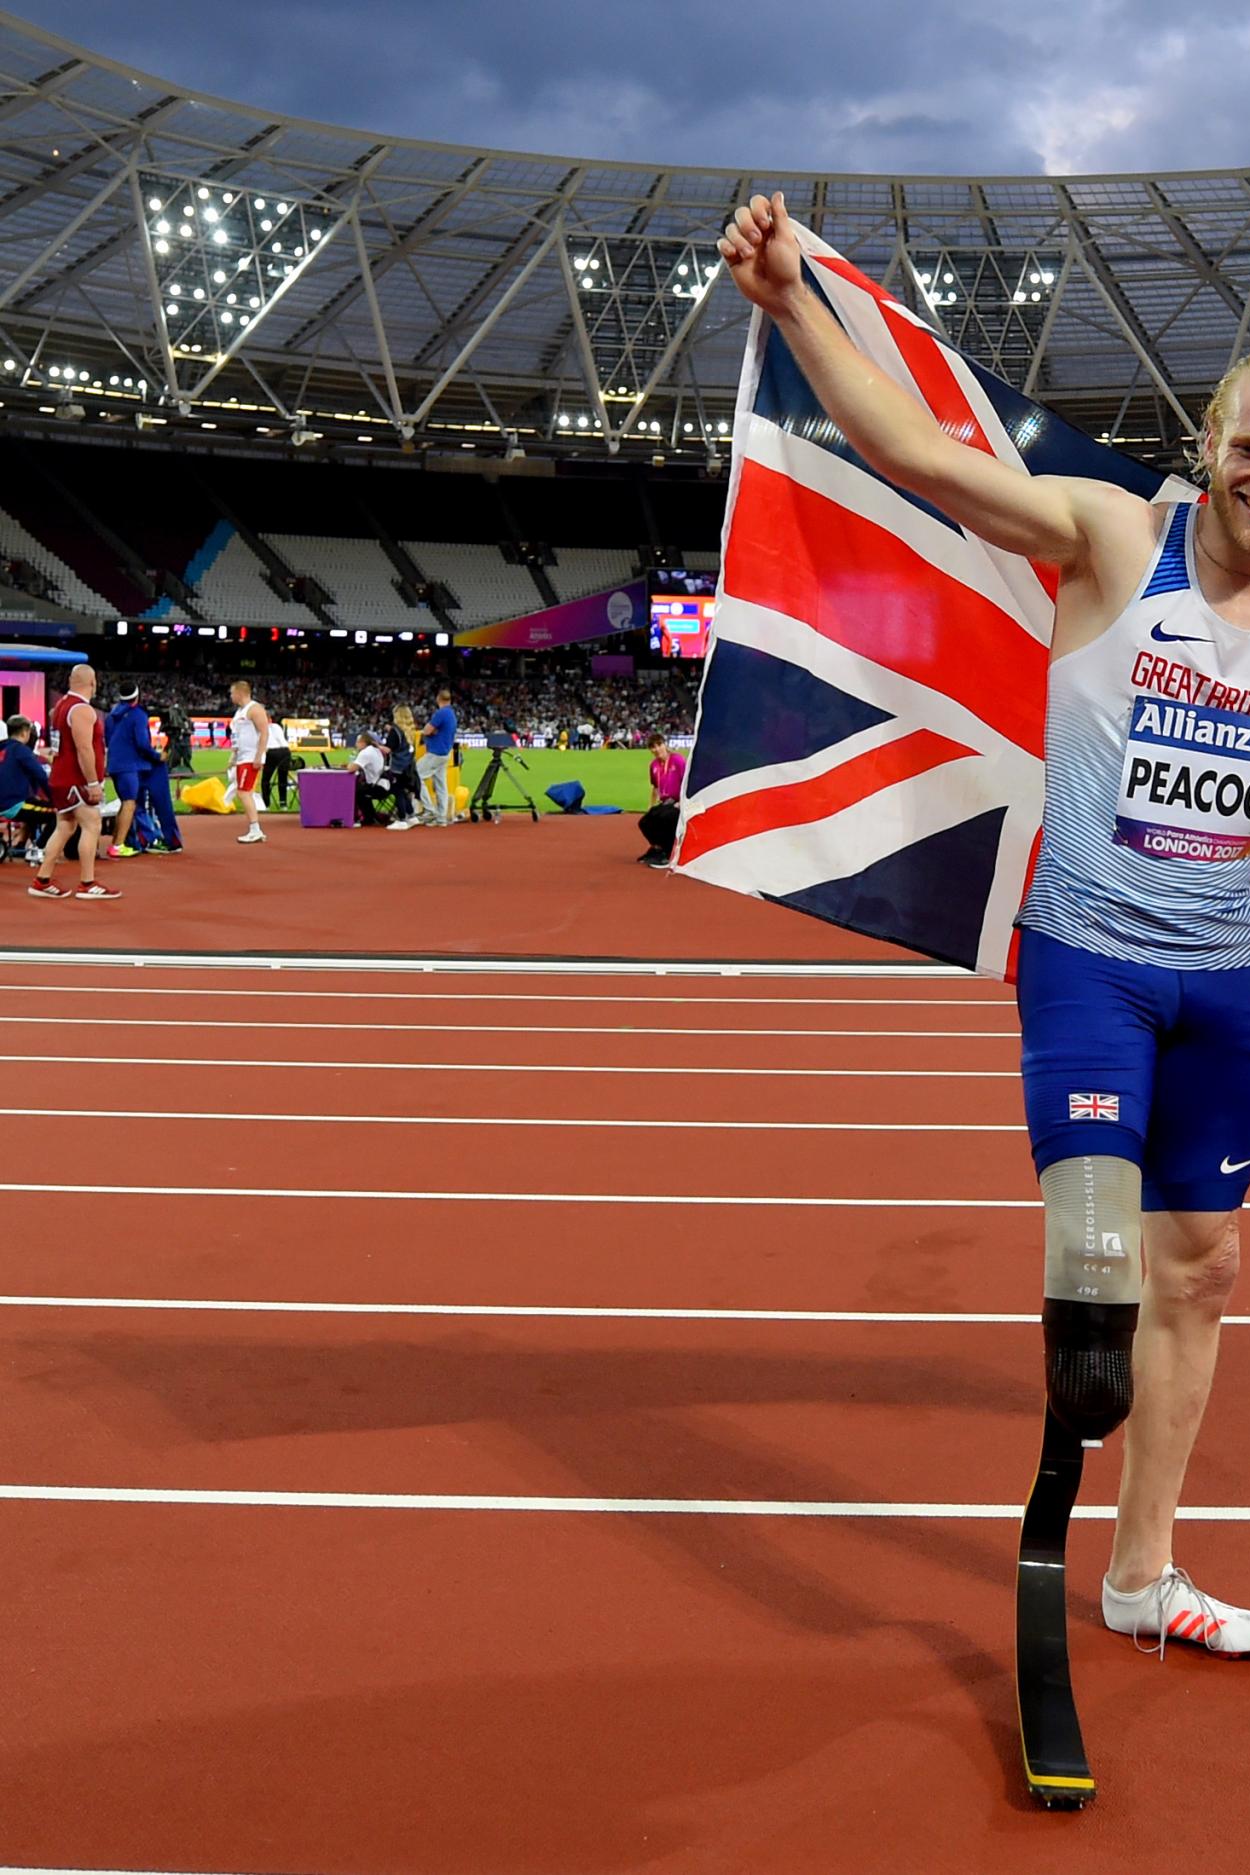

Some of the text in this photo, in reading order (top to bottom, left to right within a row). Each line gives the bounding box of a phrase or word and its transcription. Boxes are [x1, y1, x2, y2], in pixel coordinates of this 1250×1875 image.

[1130, 651, 1211, 704] GREAT
[1143, 834, 1244, 859] LONDON 2017
[1167, 830, 1184, 839] Para
